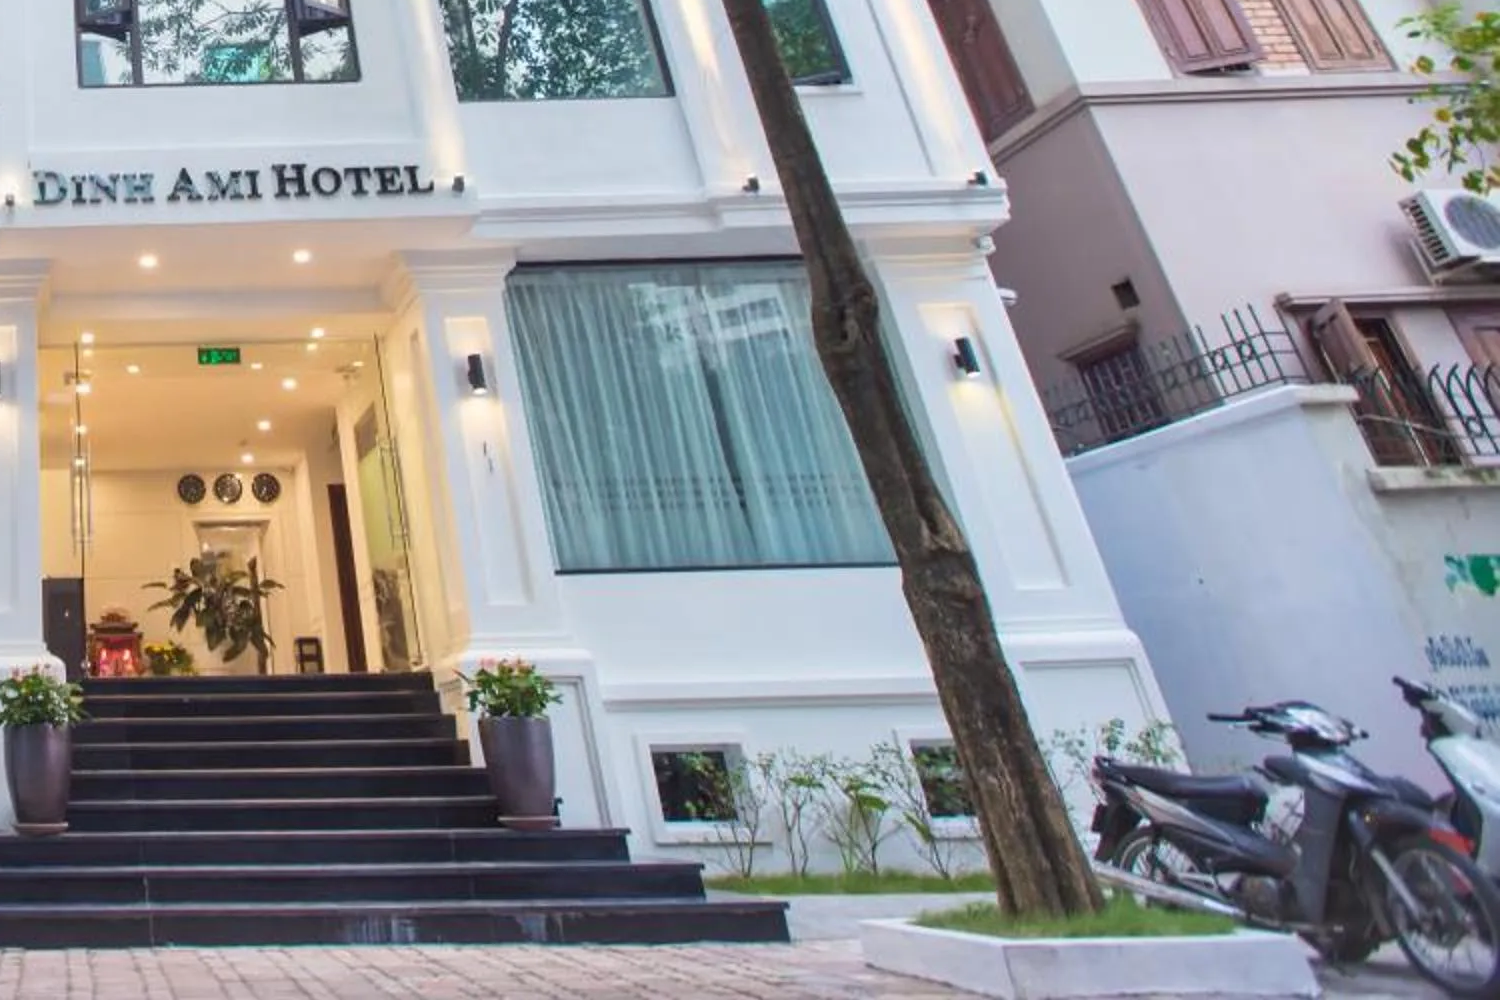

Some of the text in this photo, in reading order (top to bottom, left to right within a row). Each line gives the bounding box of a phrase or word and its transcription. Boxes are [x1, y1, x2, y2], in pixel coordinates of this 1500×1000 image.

[33, 163, 435, 205] DINH AMI HOTEL
